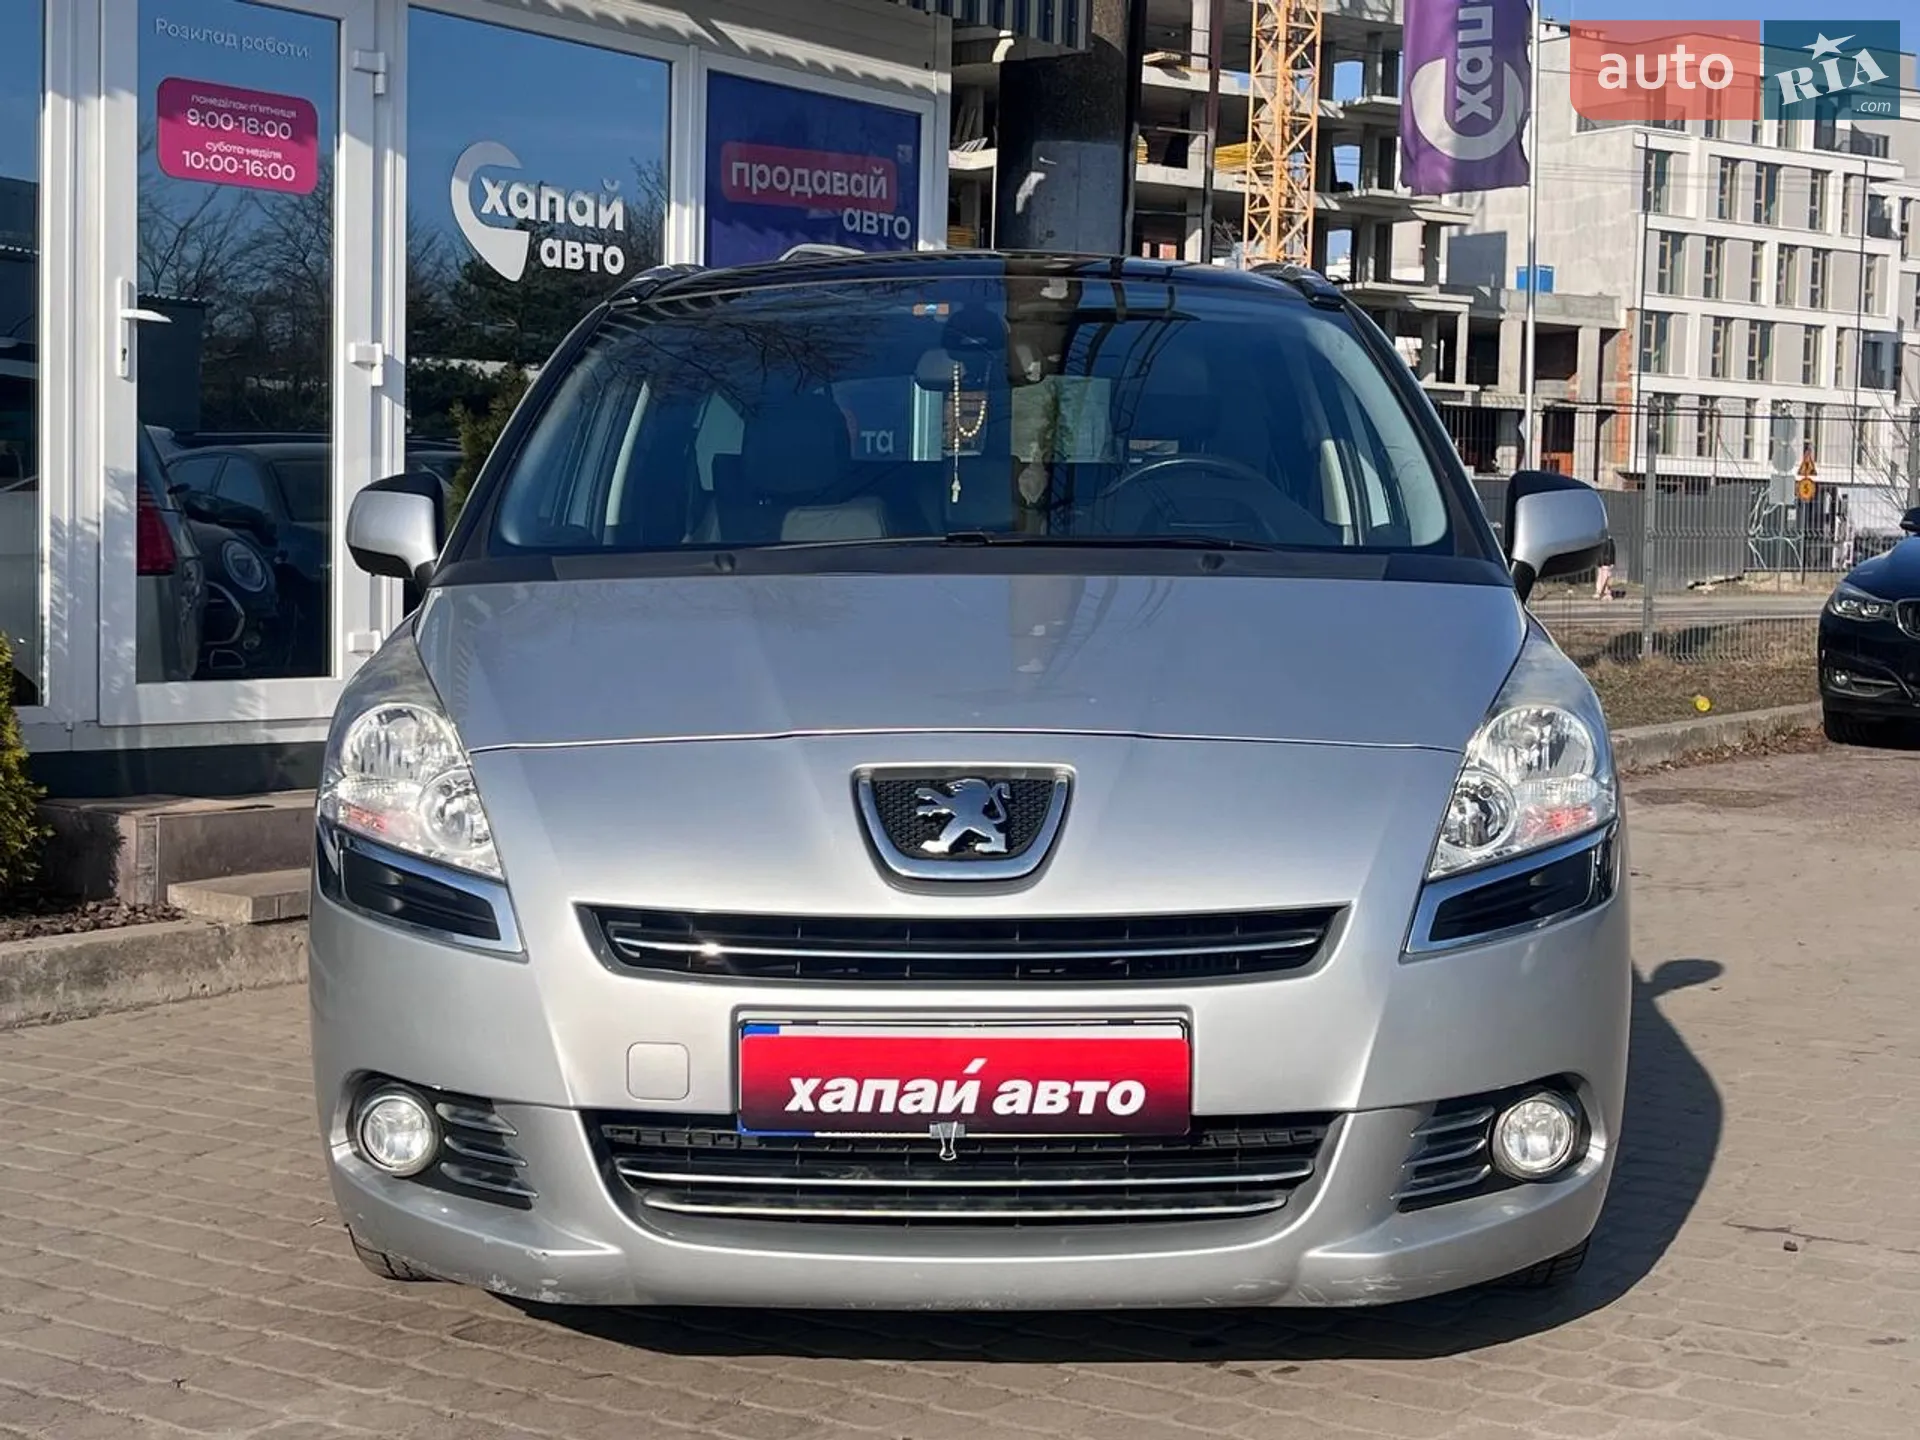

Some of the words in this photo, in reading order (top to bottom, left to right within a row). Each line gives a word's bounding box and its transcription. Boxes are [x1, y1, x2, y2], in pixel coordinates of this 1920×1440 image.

[155, 17, 237, 49] Розклад
[187, 108, 292, 140] 9:00-18:00
[182, 150, 296, 182] 10:00-16:00
[731, 161, 888, 200] продавай
[480, 177, 624, 231] хапай
[842, 207, 911, 240] авто
[540, 238, 625, 276] авто
[992, 1078, 1146, 1116] авто
